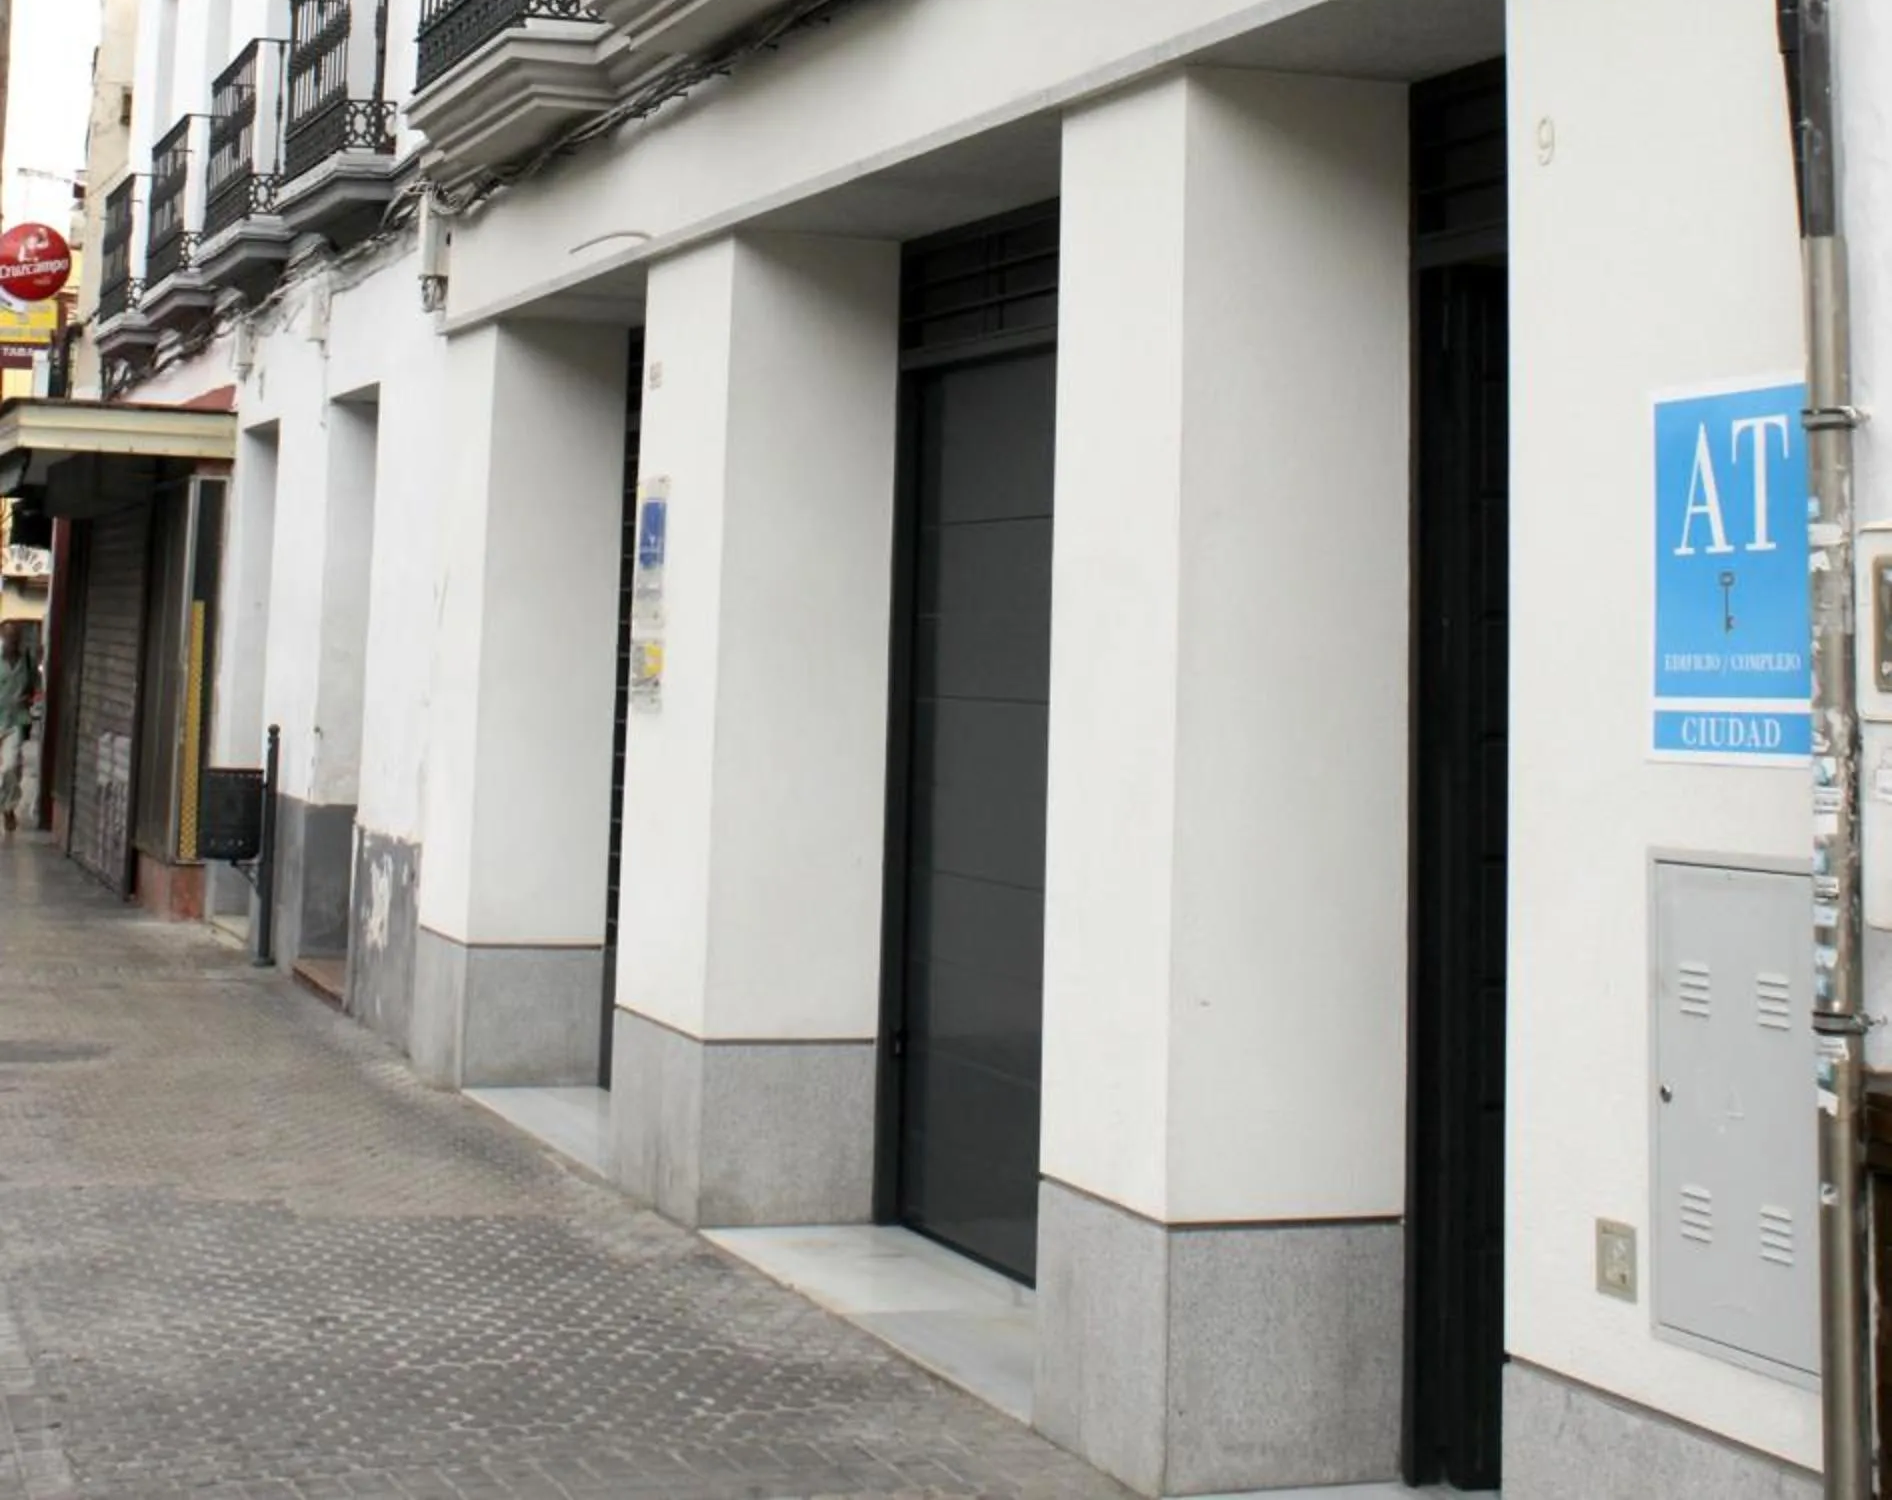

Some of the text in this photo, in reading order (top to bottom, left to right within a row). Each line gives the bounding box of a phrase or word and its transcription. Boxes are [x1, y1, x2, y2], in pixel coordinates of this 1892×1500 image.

[1537, 116, 1555, 167] 9
[1673, 413, 1789, 555] AT
[1682, 715, 1781, 748] CIUDAD
